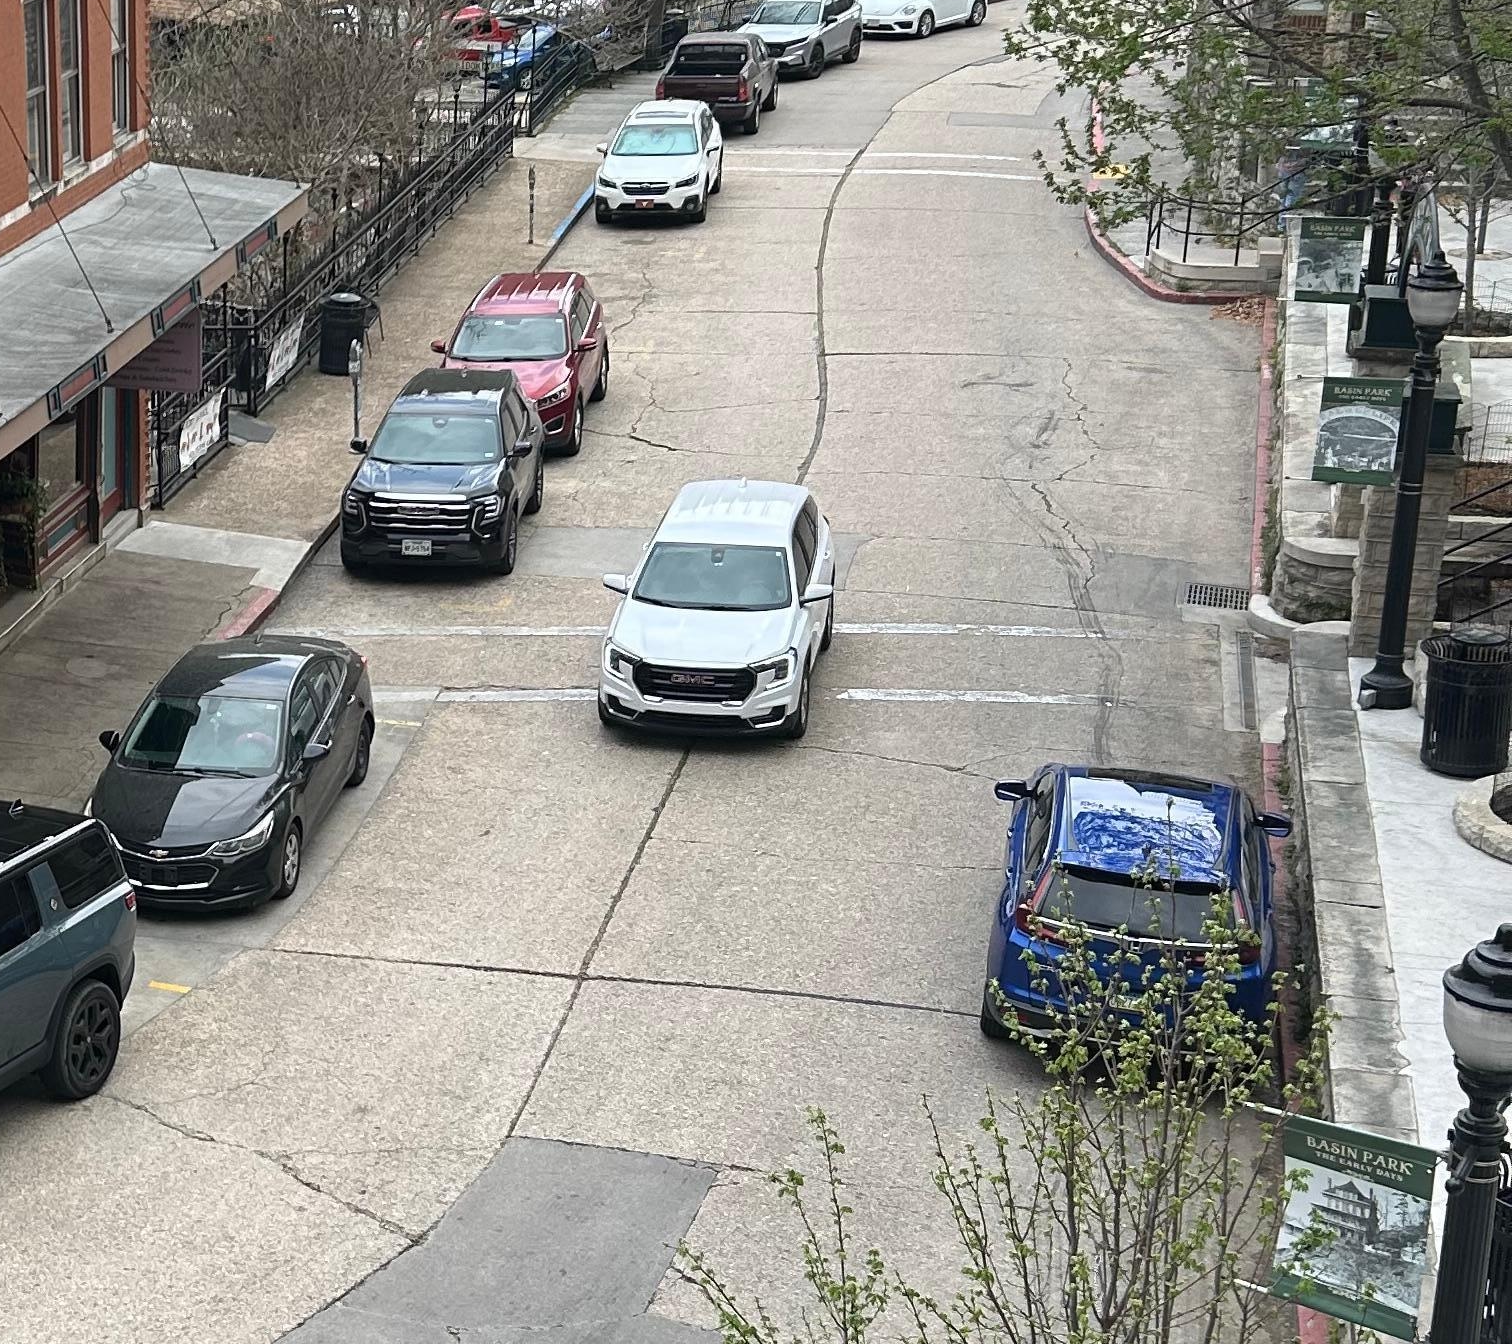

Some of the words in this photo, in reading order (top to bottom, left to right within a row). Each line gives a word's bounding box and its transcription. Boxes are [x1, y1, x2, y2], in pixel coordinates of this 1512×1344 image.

[1334, 386, 1363, 395] BASIN
[1364, 387, 1393, 397] PARK
[671, 673, 715, 685] GMC
[1306, 1135, 1358, 1161] BASIN
[1363, 1150, 1414, 1176] PARK
[1315, 1151, 1336, 1162] THE
[1339, 1157, 1373, 1173] EARLY
[1376, 1167, 1404, 1183] DAYS
